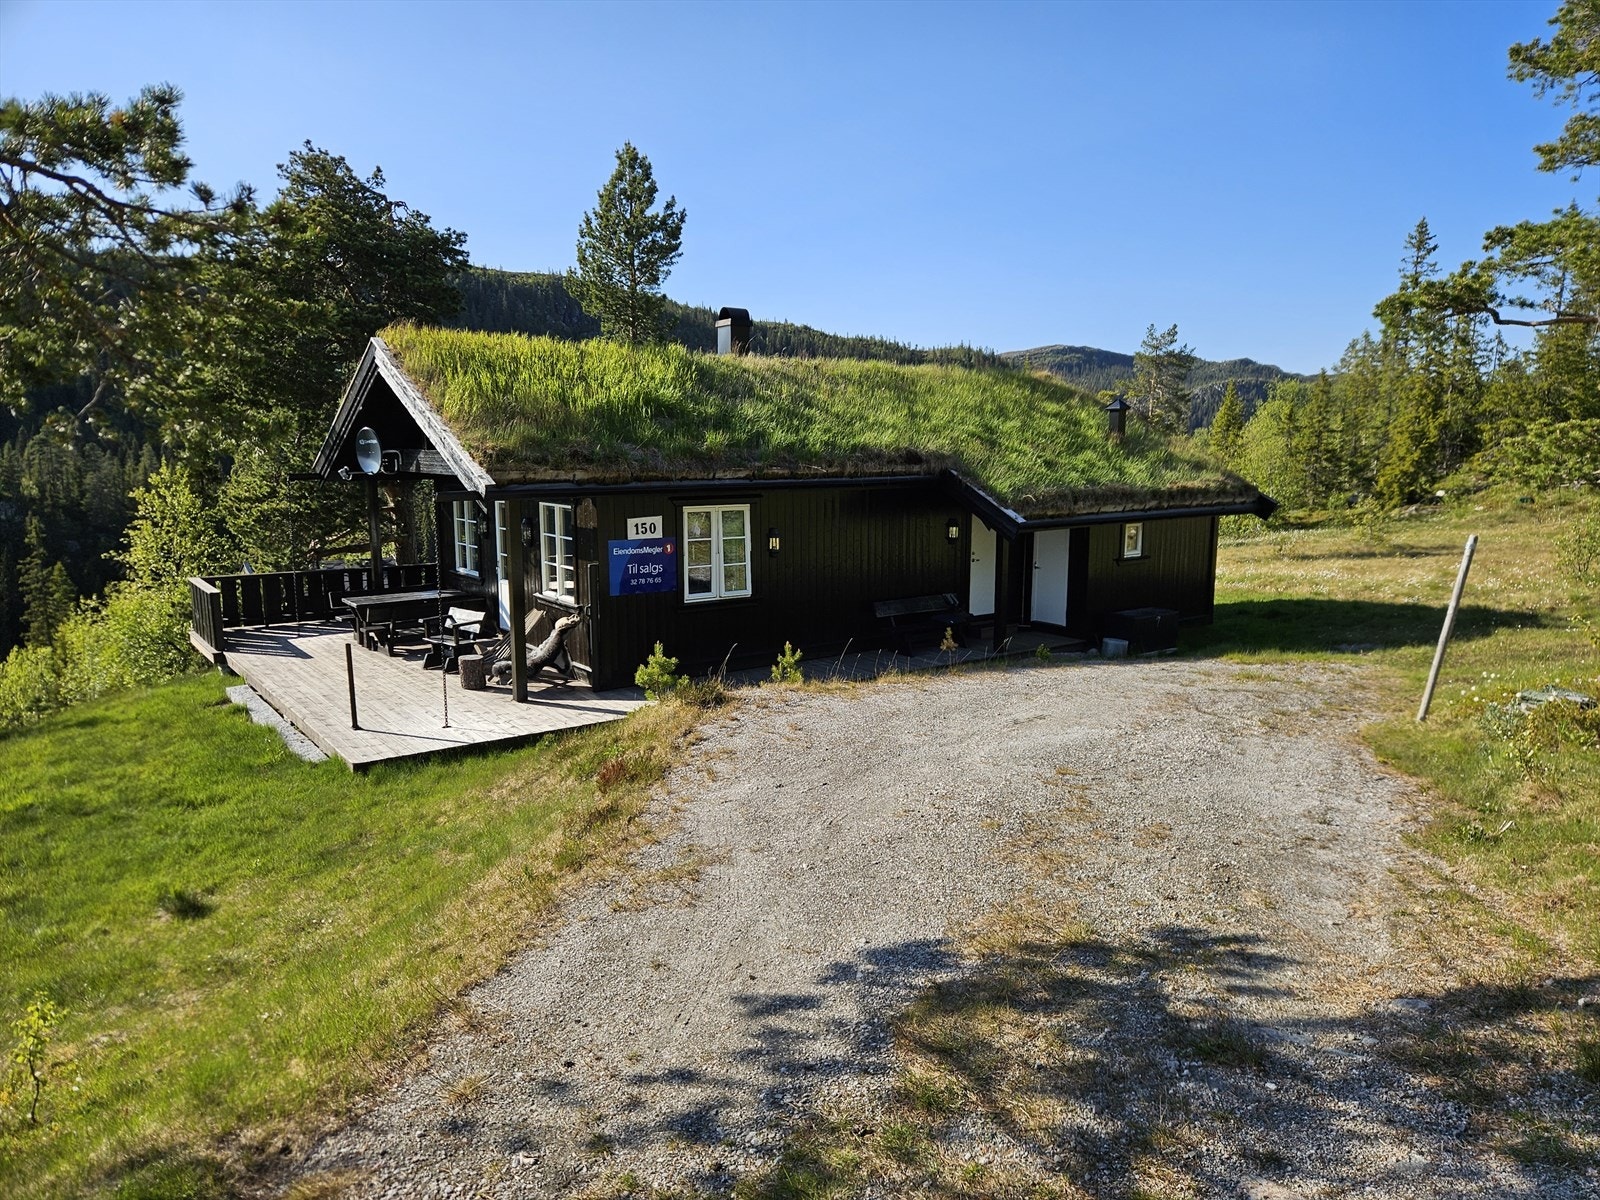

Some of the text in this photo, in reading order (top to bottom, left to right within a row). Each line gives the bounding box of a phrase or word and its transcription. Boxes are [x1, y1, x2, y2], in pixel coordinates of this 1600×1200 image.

[633, 522, 657, 535] 150
[613, 546, 663, 555] EiendomsMegler
[627, 563, 663, 575] Til salgs
